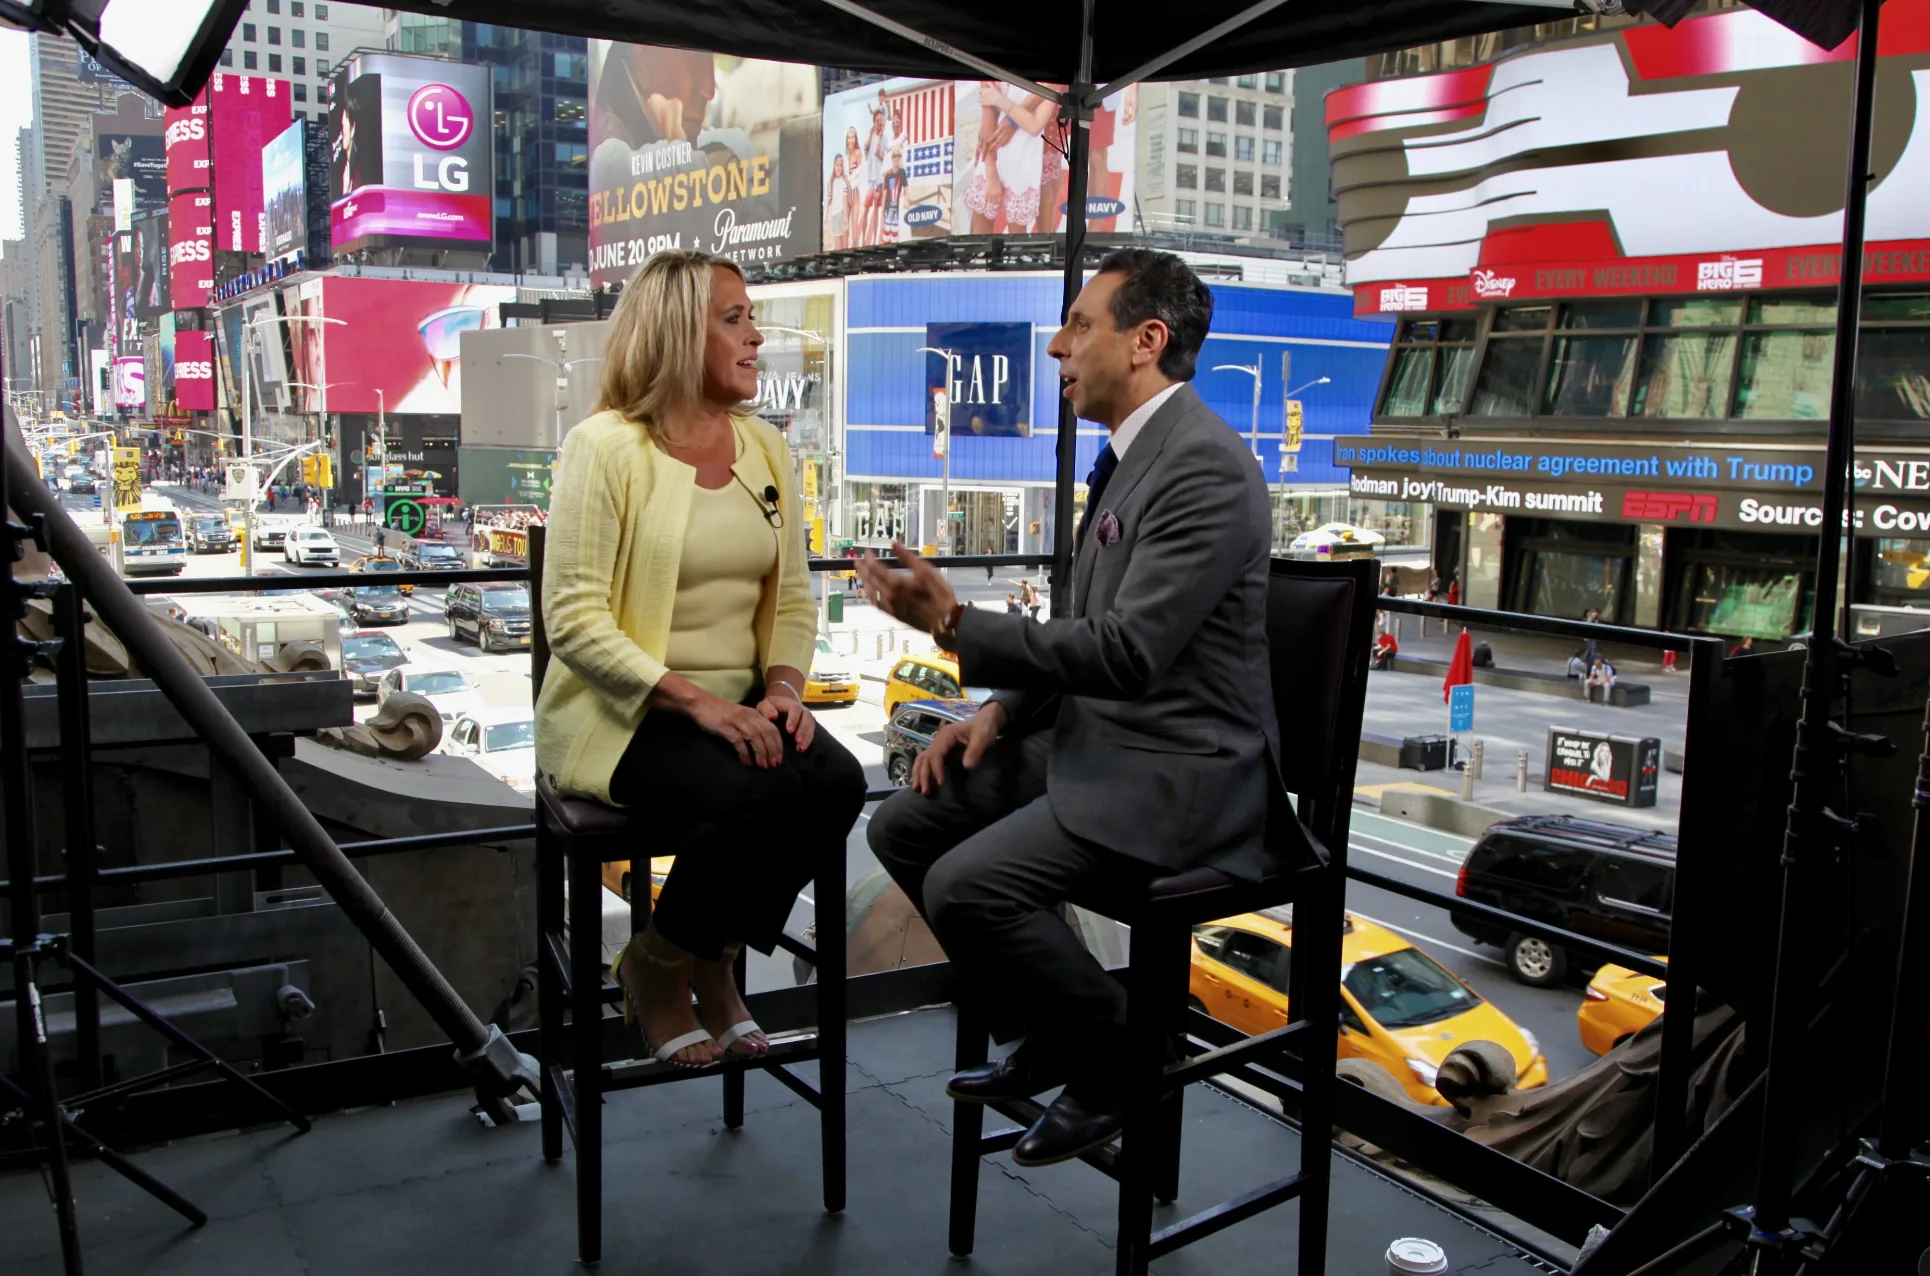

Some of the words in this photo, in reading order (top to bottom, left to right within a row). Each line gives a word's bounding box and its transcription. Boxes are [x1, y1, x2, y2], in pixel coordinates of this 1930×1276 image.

[413, 152, 469, 192] LG
[631, 151, 653, 176] KEVIN
[655, 141, 692, 171] COSTNER
[417, 212, 464, 222] www.LG.com
[908, 212, 920, 223] OLD
[921, 210, 938, 221] NAVY
[1088, 203, 1118, 213] NAVY
[711, 208, 792, 254] Paramount
[594, 241, 625, 270] JUNE
[628, 239, 645, 265] 20
[725, 244, 782, 262] NETWORK
[1535, 269, 1587, 290] EVERY
[1593, 264, 1678, 289] WEEKEND
[1697, 278, 1732, 290] HERO
[1698, 261, 1732, 279] BIG
[1733, 259, 1763, 284] 6
[1380, 289, 1404, 303] BIG
[785, 372, 821, 381] JEANS
[949, 355, 1008, 404] GAP
[408, 451, 424, 461] hut
[1337, 444, 1356, 460] Iran
[1360, 445, 1420, 465] spokes
[1423, 447, 1460, 467] about
[1465, 450, 1532, 470] nuclear
[1538, 455, 1659, 476] agreement
[1666, 457, 1718, 478] with
[1726, 457, 1814, 487] Trump
[1351, 474, 1398, 495] Rodman
[1437, 482, 1520, 508] Trump-Kim
[1525, 491, 1603, 513] summit
[1622, 491, 1719, 523] ESPN
[857, 511, 905, 540] GAP
[1739, 498, 1864, 528] Sourcs:
